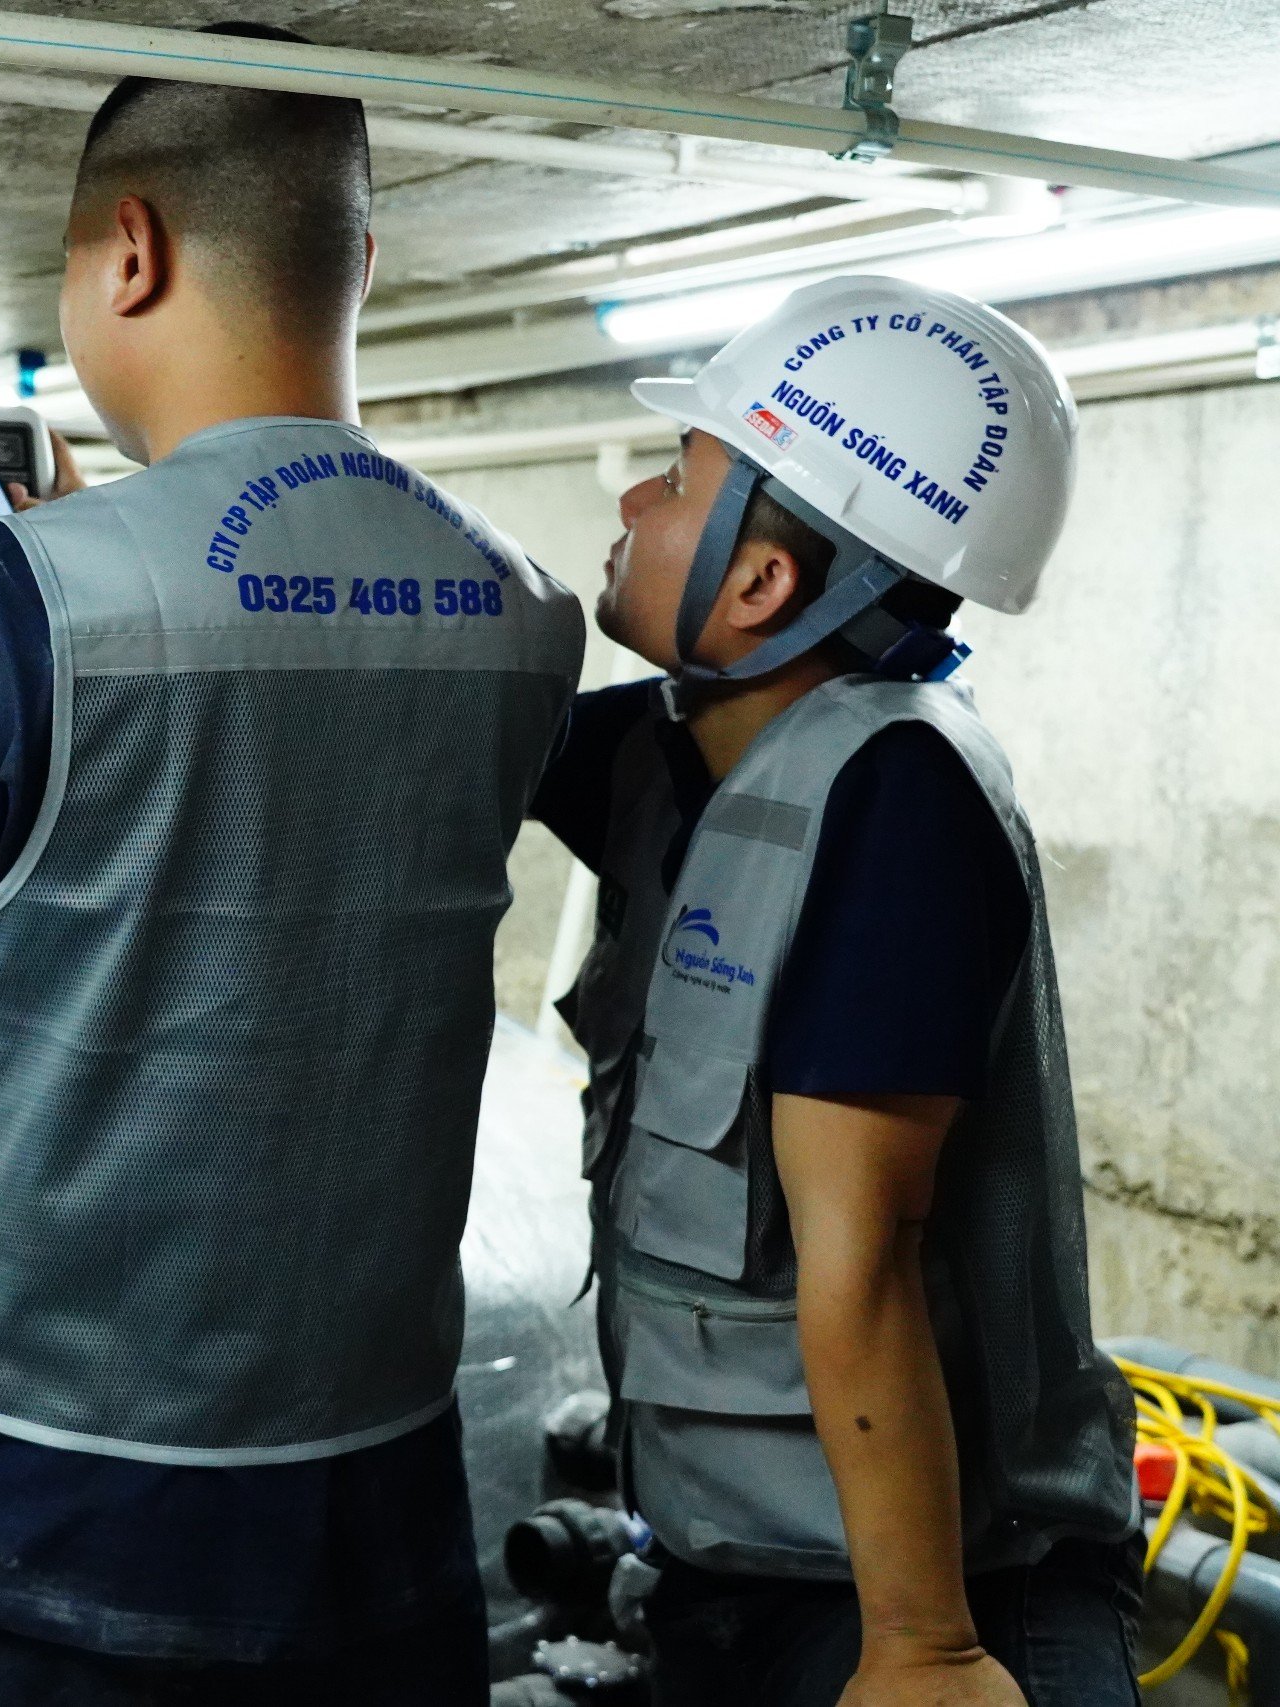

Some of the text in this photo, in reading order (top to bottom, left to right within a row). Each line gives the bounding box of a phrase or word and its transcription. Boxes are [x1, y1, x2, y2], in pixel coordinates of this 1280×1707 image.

[783, 325, 845, 372] CÔNG
[850, 314, 879, 333] TY
[977, 372, 1009, 415] TẬP
[239, 476, 280, 512] TẬP
[902, 470, 969, 525] XANH
[221, 505, 252, 535] CP
[206, 531, 240, 573] CTY
[237, 573, 503, 617] 0325 468 588
